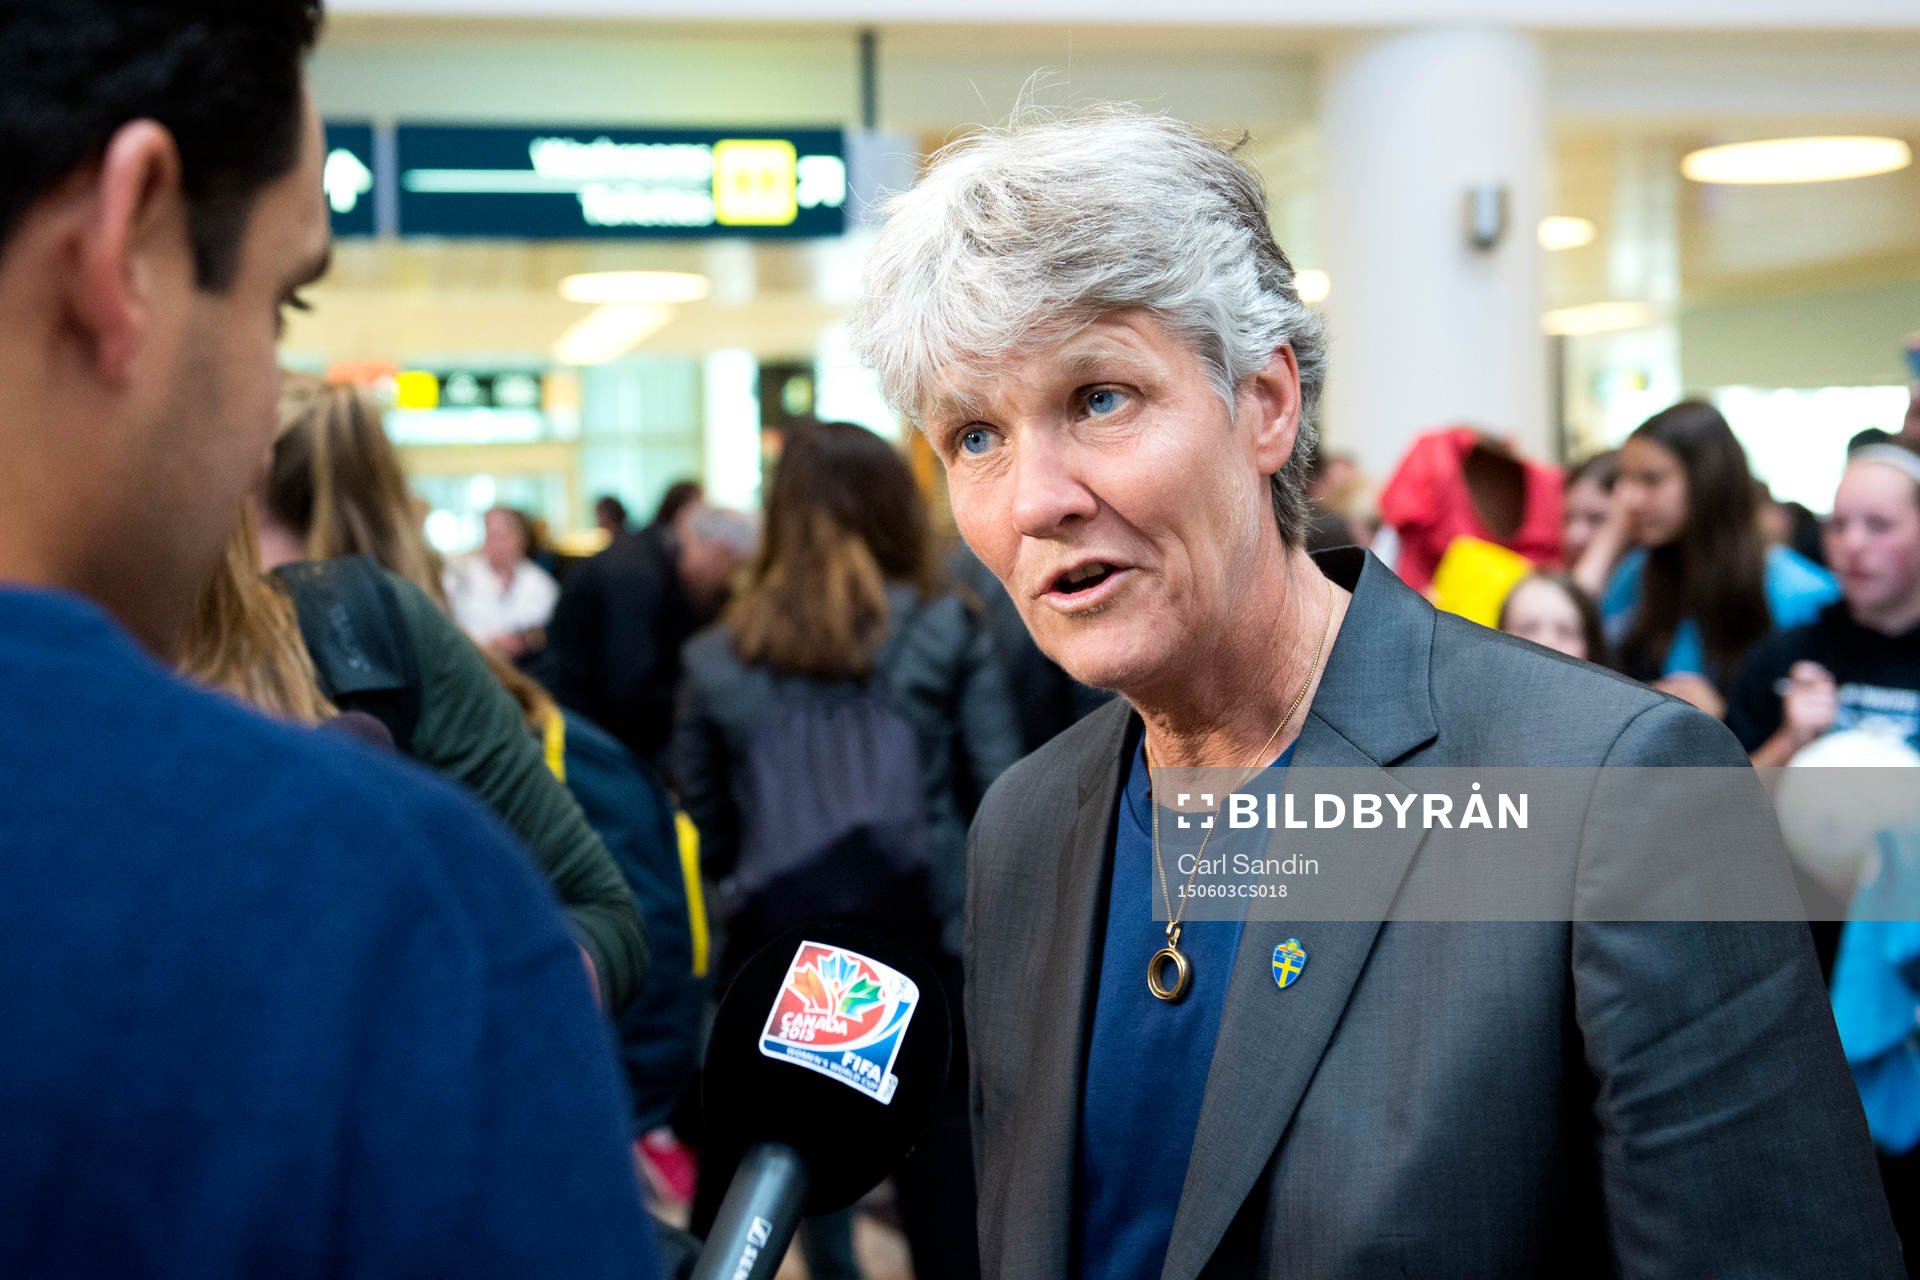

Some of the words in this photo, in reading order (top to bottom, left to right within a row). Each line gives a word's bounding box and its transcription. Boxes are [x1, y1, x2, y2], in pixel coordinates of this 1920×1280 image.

[779, 1024, 815, 1042] 2015
[781, 1011, 848, 1037] CANADA
[841, 1050, 881, 1083] FIFA
